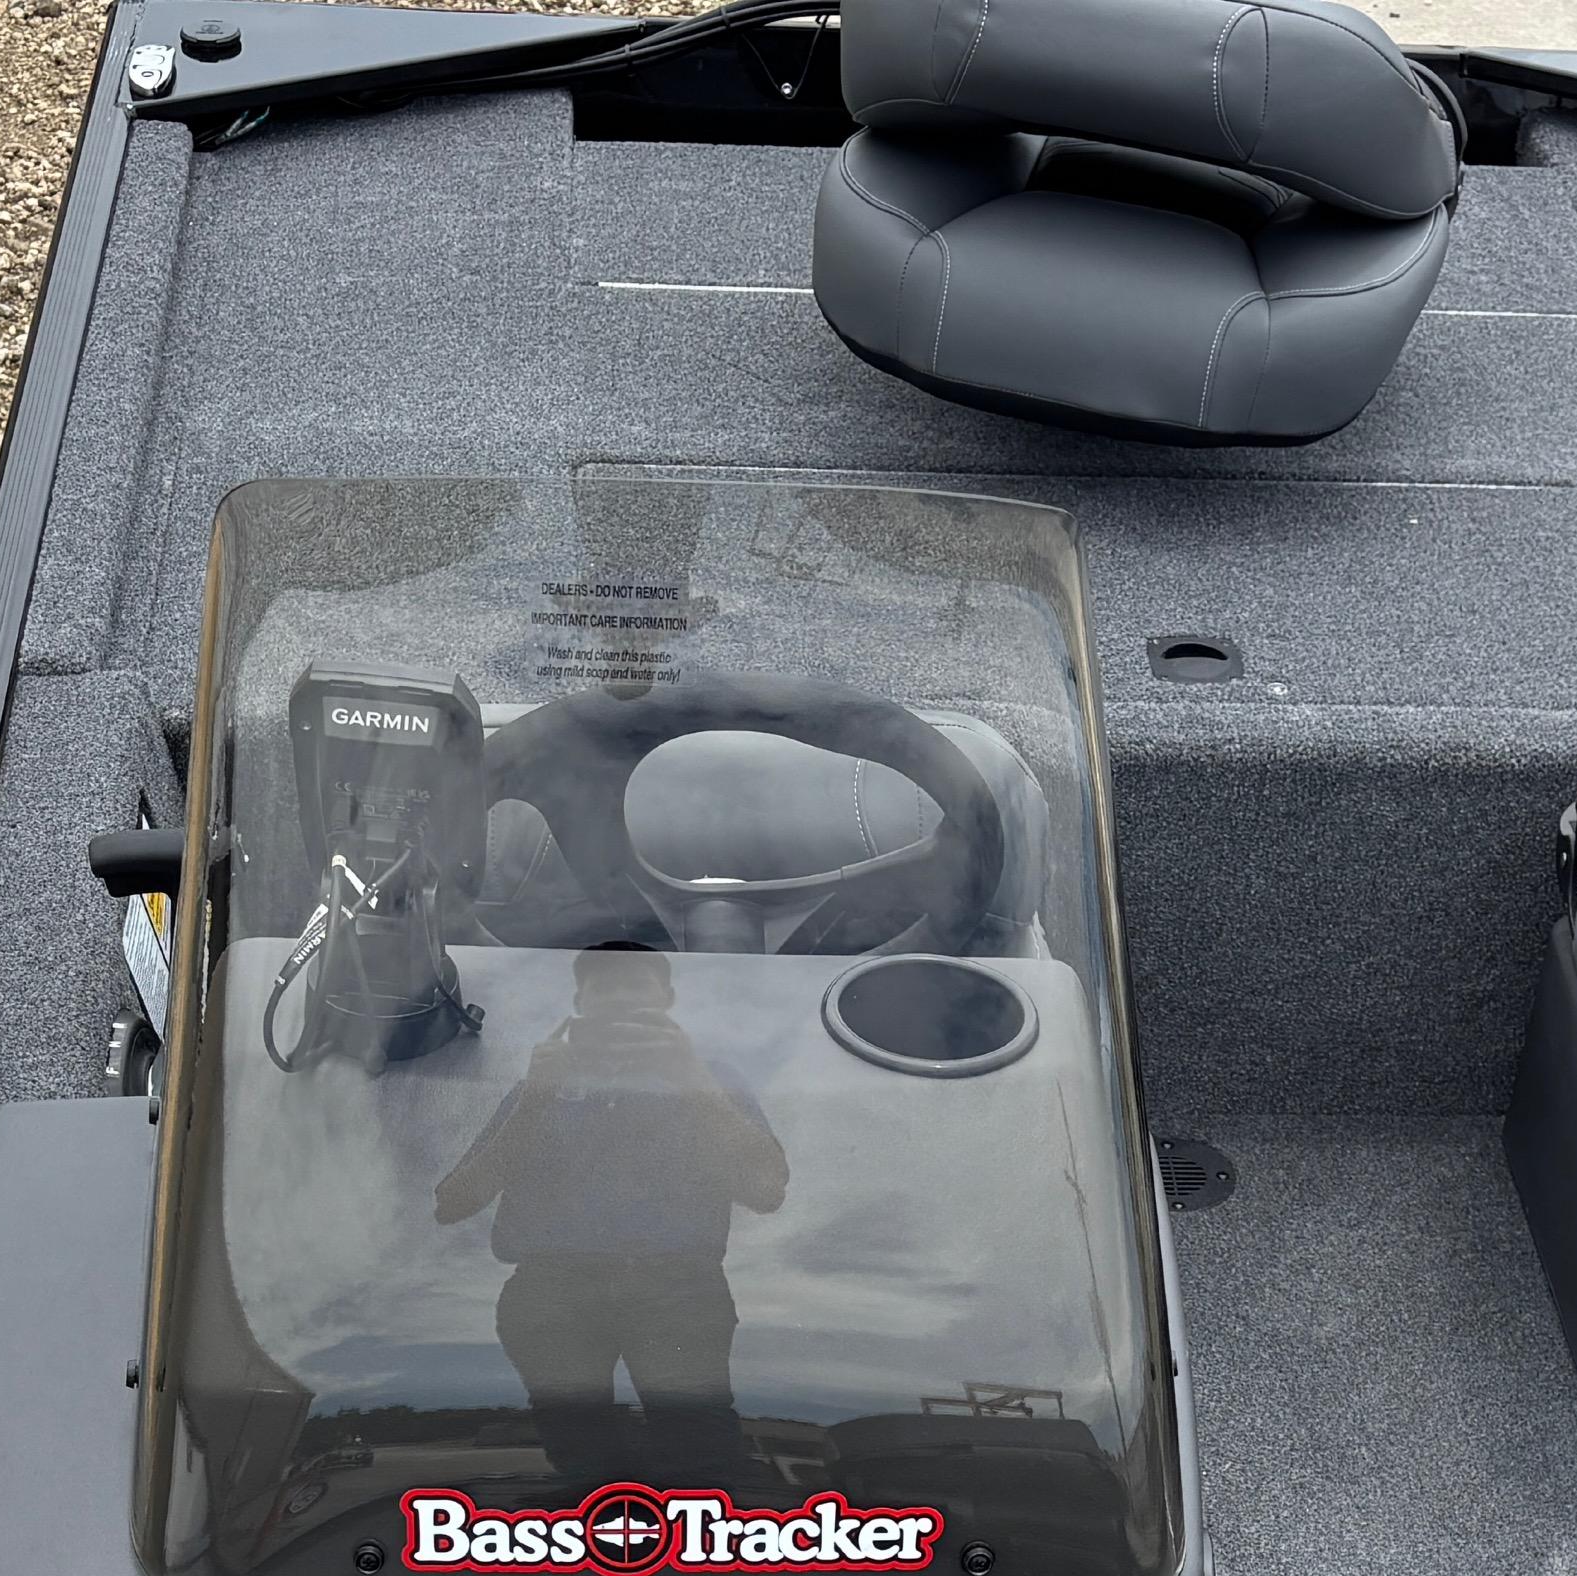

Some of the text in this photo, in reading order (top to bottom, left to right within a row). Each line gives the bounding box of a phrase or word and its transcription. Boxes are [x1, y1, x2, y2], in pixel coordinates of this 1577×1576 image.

[541, 582, 588, 597] DEALERS
[596, 584, 611, 598] DO
[612, 585, 634, 599] NOT
[635, 586, 679, 600] REMOVE
[531, 611, 687, 631] IMPORTANT CARE INFORMATION
[547, 646, 672, 666] Wash and clean this plastic
[536, 664, 563, 679] using
[563, 665, 585, 678] mild
[585, 667, 610, 681] soap
[610, 667, 629, 680] and
[630, 668, 656, 681] water
[331, 707, 430, 734] GARMIN
[293, 929, 326, 965] ARMIN
[411, 1498, 934, 1563] Bass Tracker
